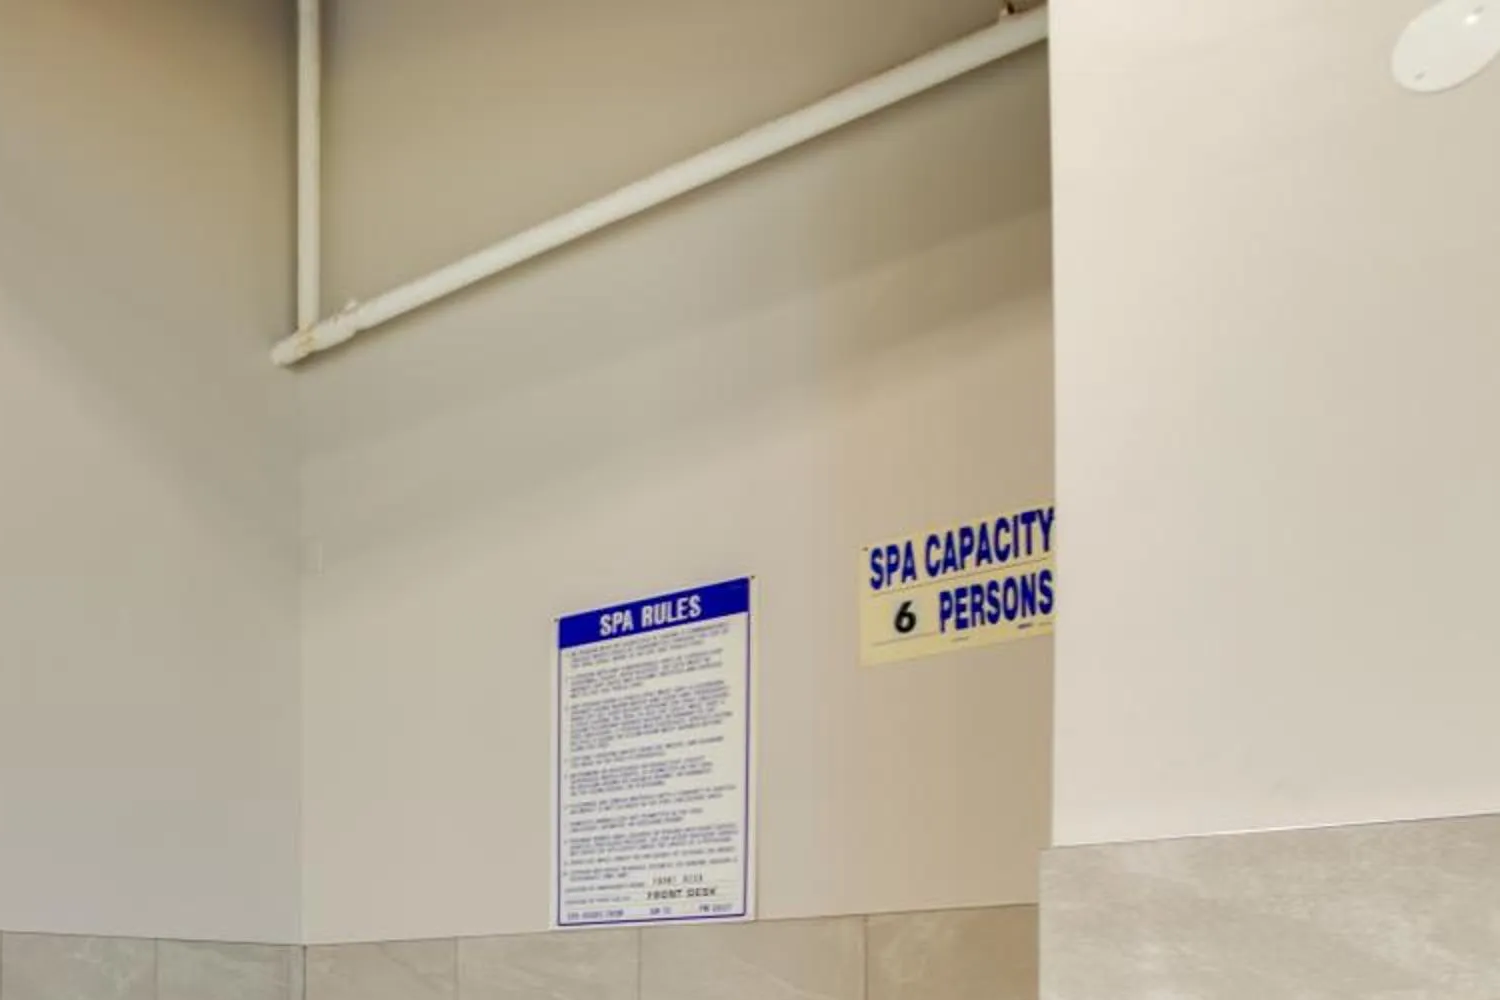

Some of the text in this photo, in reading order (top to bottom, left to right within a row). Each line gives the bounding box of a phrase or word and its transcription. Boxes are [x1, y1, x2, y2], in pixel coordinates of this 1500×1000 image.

[870, 507, 1054, 590] SPA CAPACITY
[600, 595, 702, 637] SPA RULES
[894, 569, 1054, 634] 6 PERSONS
